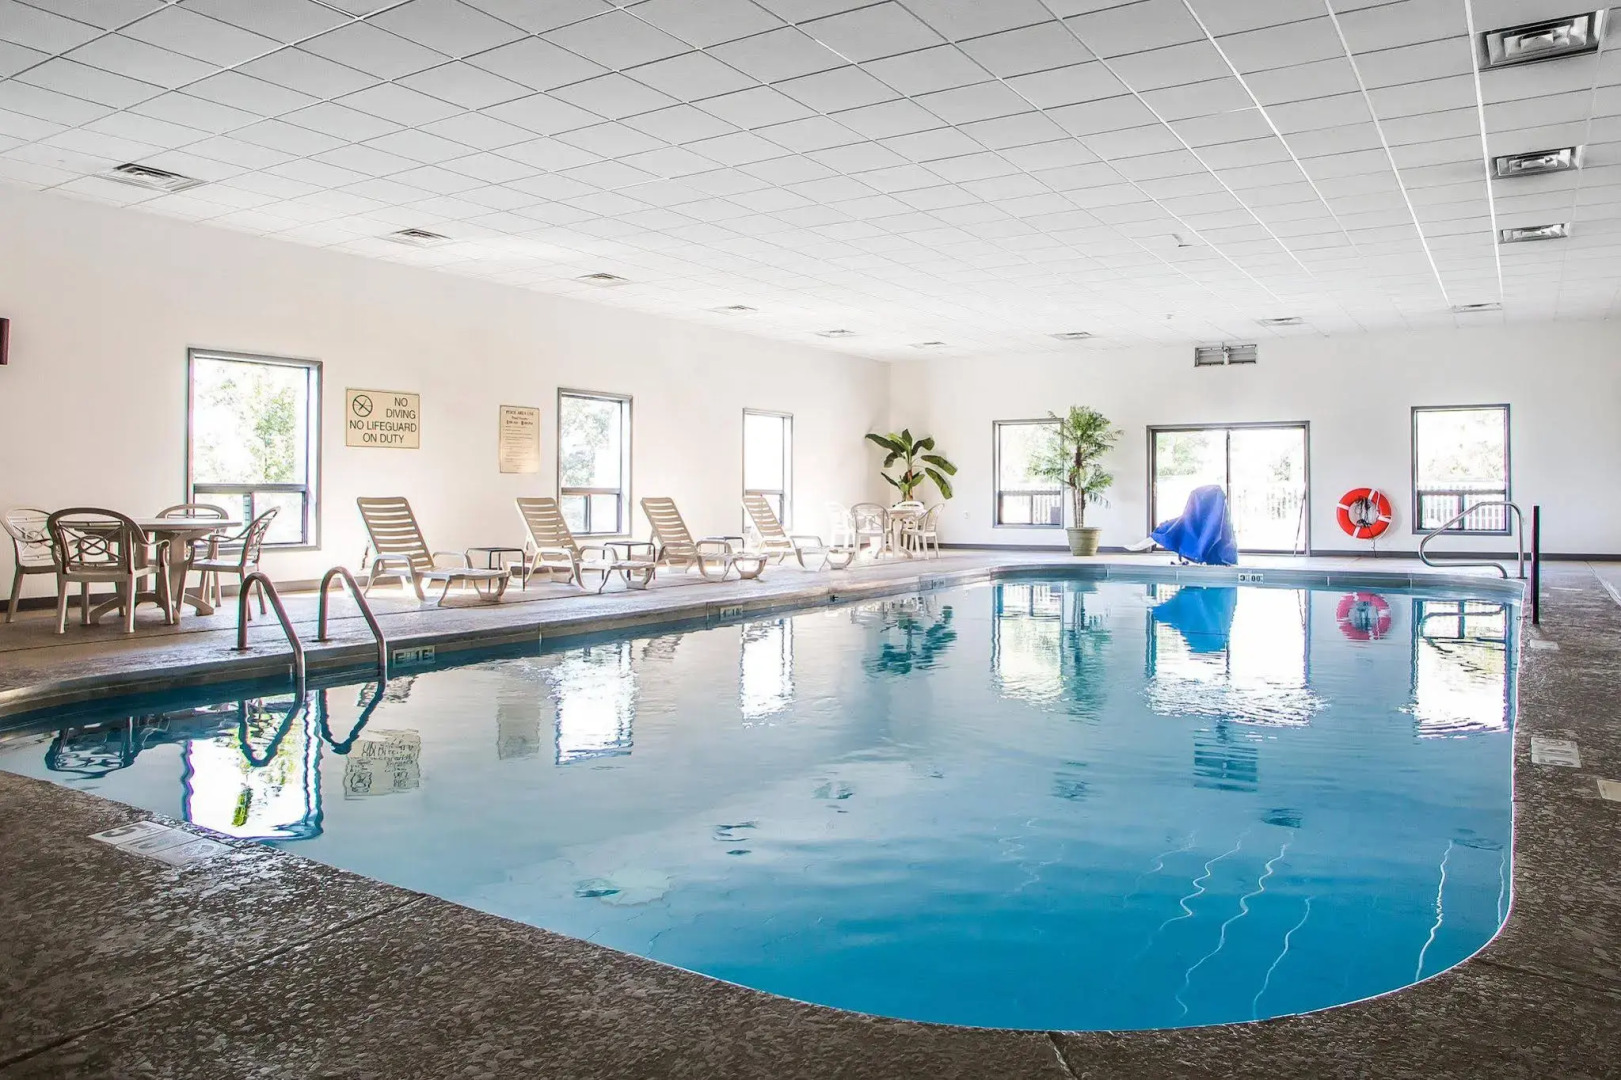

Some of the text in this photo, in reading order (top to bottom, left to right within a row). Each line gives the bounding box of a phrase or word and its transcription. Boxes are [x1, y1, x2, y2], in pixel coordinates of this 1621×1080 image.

[394, 397, 408, 407] NO
[386, 408, 416, 420] DIVING
[349, 420, 417, 433] NO LIFEGUARD
[362, 432, 405, 444] ON DUTY
